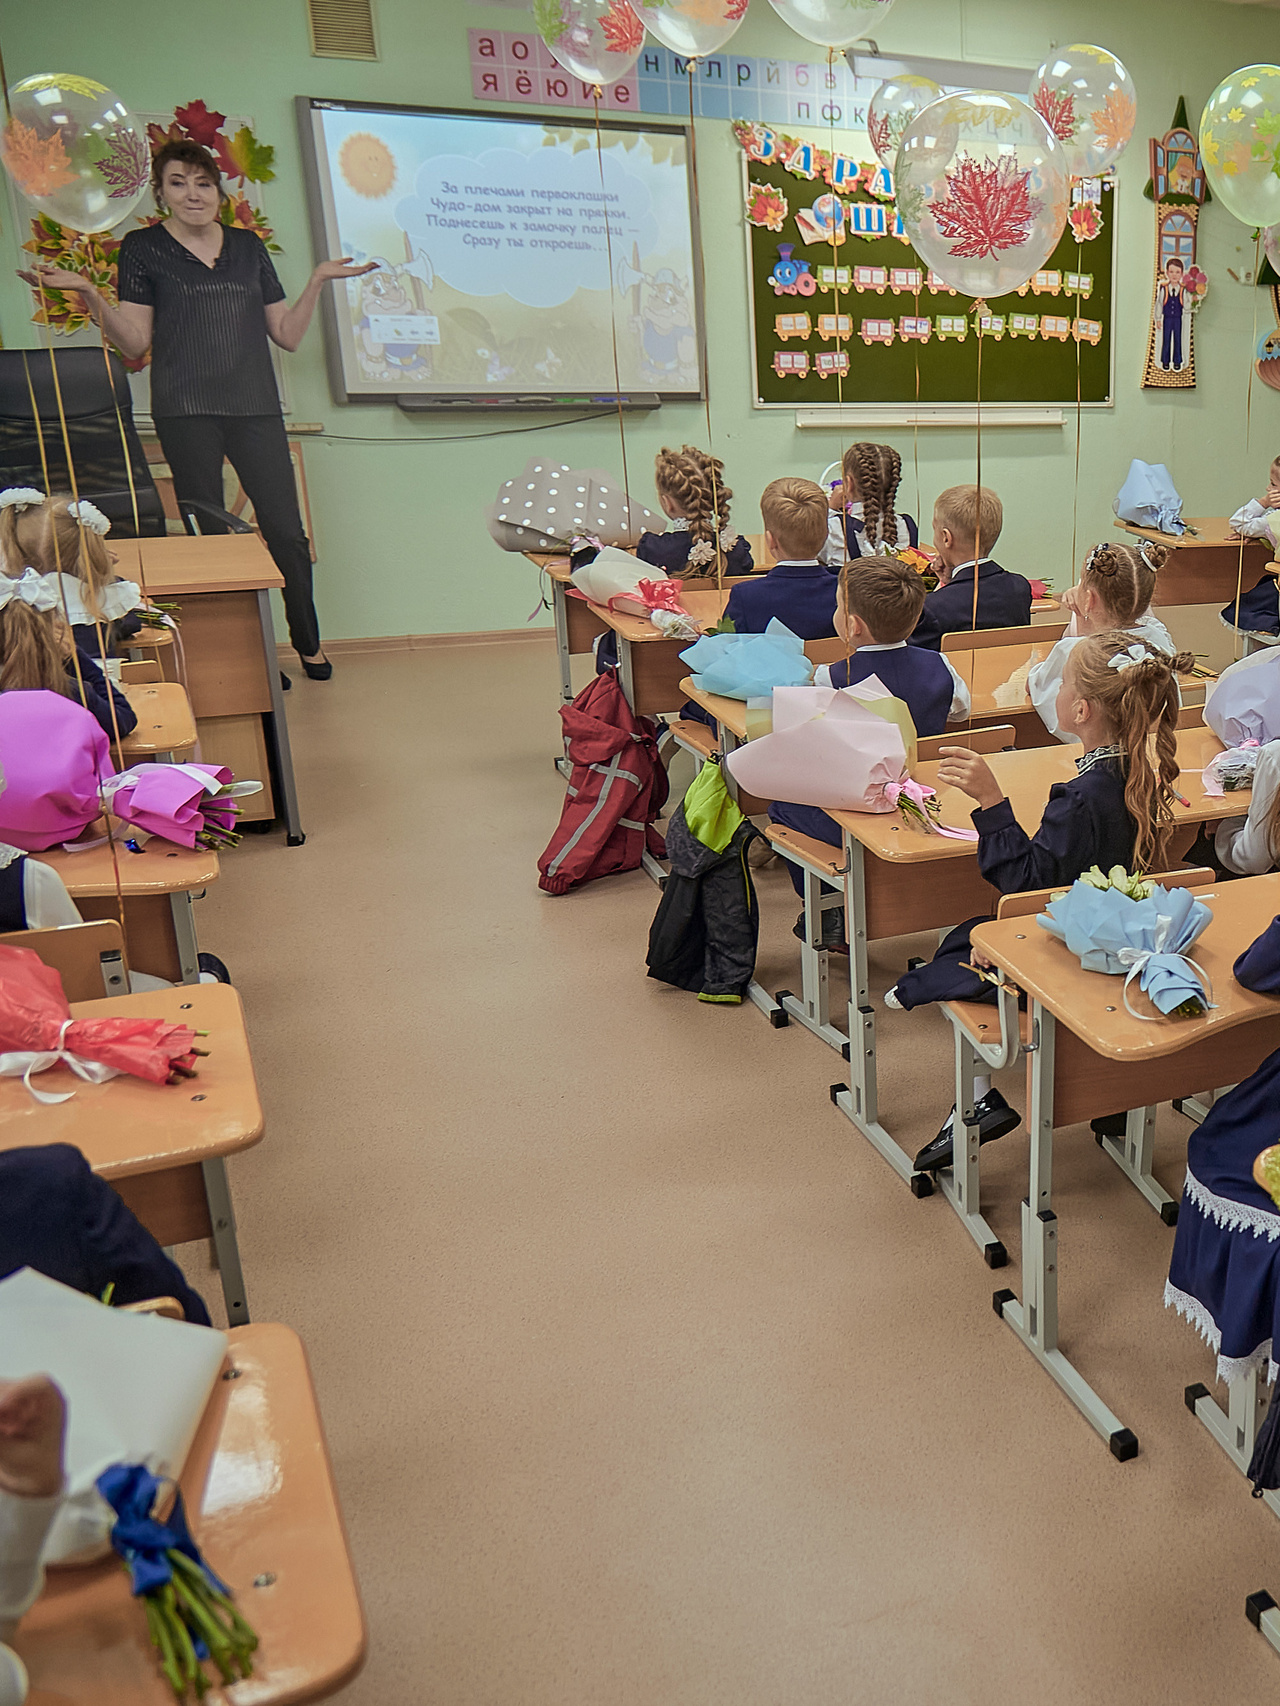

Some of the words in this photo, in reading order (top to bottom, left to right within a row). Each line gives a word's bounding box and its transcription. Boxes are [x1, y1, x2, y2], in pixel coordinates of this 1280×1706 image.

[441, 181, 459, 194] За
[464, 185, 525, 198] плечами
[530, 189, 619, 202] первоклашки
[430, 197, 502, 213] Чудо-дом
[506, 204, 552, 217] закрыт
[557, 207, 573, 217] на
[579, 208, 631, 221] пряжки.
[425, 213, 505, 230] Поднесешь
[510, 221, 518, 230] к
[523, 222, 577, 237] замочку
[582, 225, 624, 237] палец
[462, 233, 501, 249] Сразу
[506, 238, 524, 247] ты
